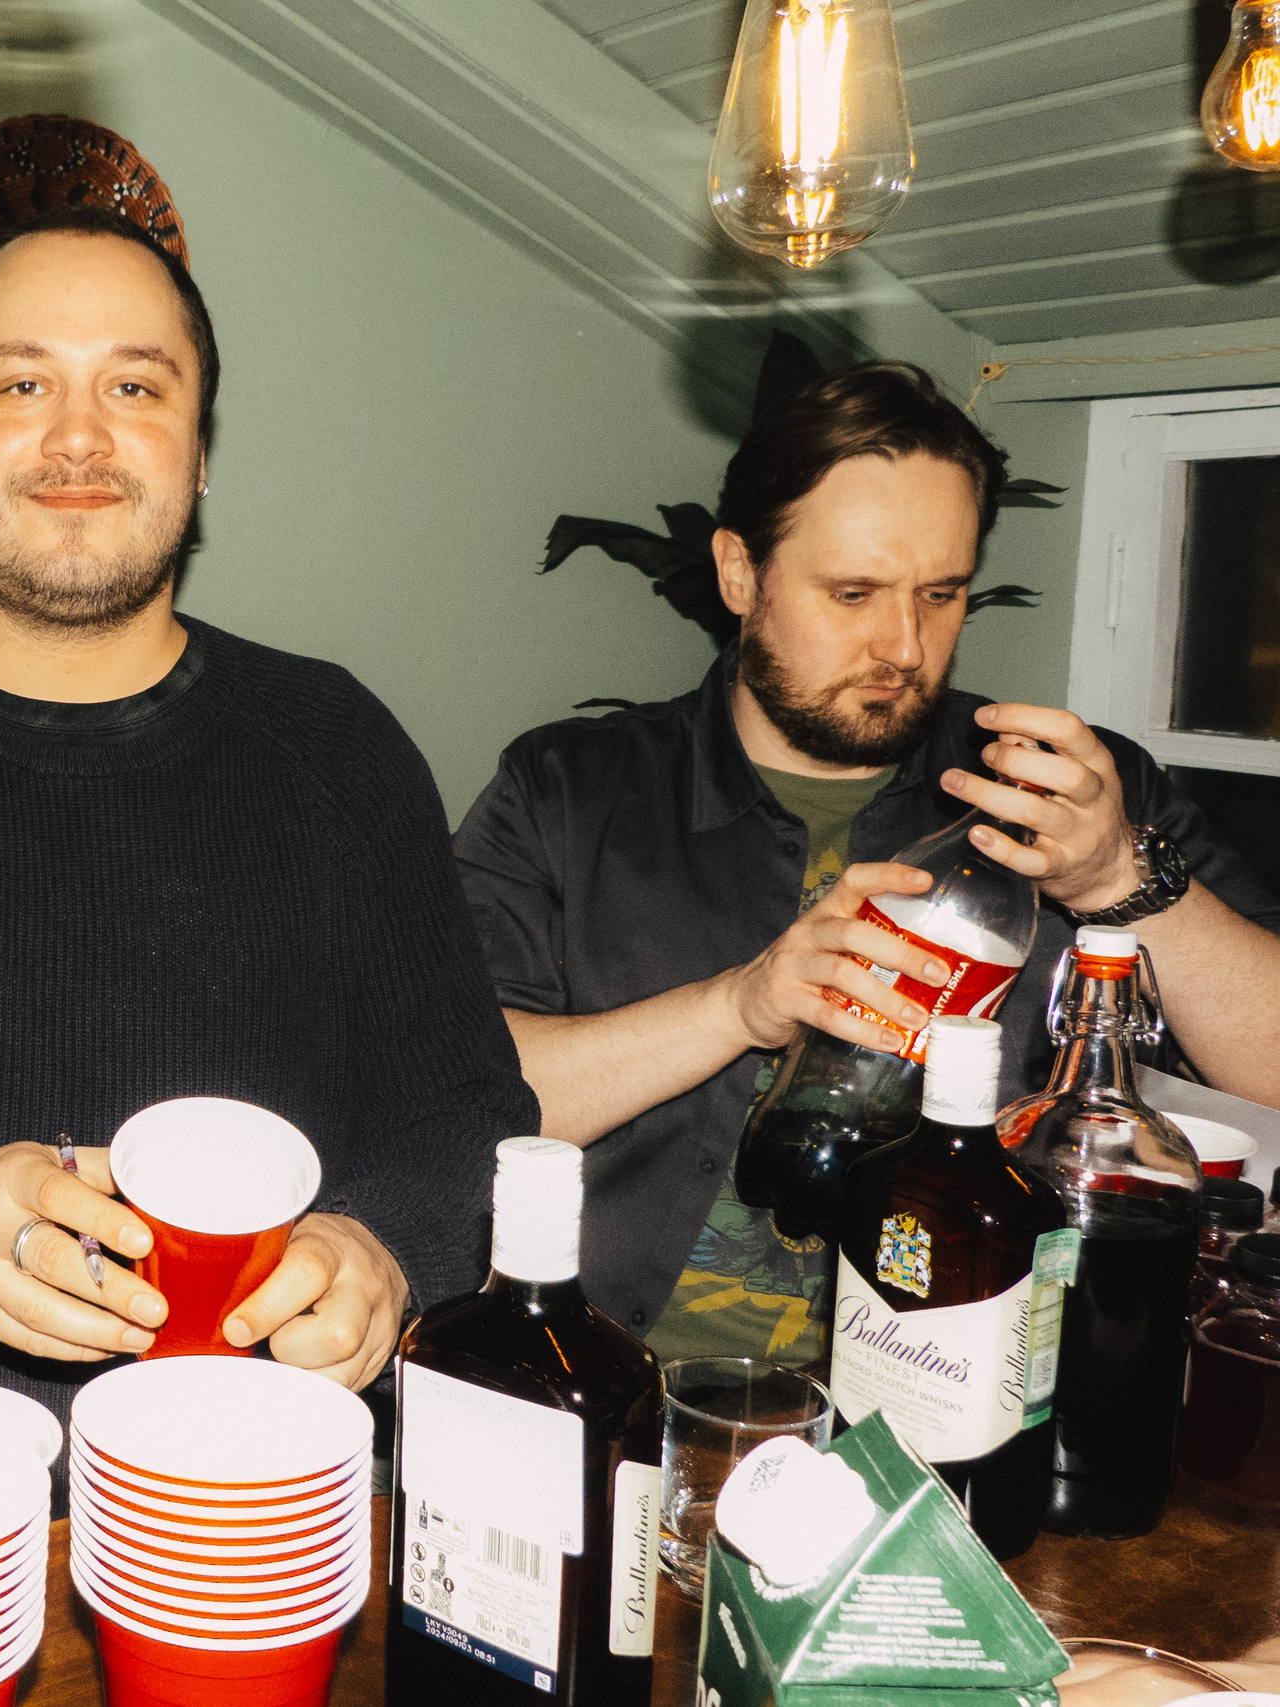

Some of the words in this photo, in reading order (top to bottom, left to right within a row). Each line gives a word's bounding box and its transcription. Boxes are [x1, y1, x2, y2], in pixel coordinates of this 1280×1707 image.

[929, 990, 952, 1018] AYTA
[946, 961, 970, 991] ISHLA
[835, 1295, 972, 1383] Ballantine's
[865, 1351, 922, 1384] FINEST
[998, 1299, 1030, 1412] Ballantine's
[834, 1350, 872, 1377] BLENDED
[874, 1372, 915, 1397] SCOTCH
[919, 1390, 965, 1414] WHISKY
[624, 1493, 651, 1634] Ballantine's
[425, 1624, 473, 1653] 2024/09/03
[474, 1648, 496, 1665] 08:51
